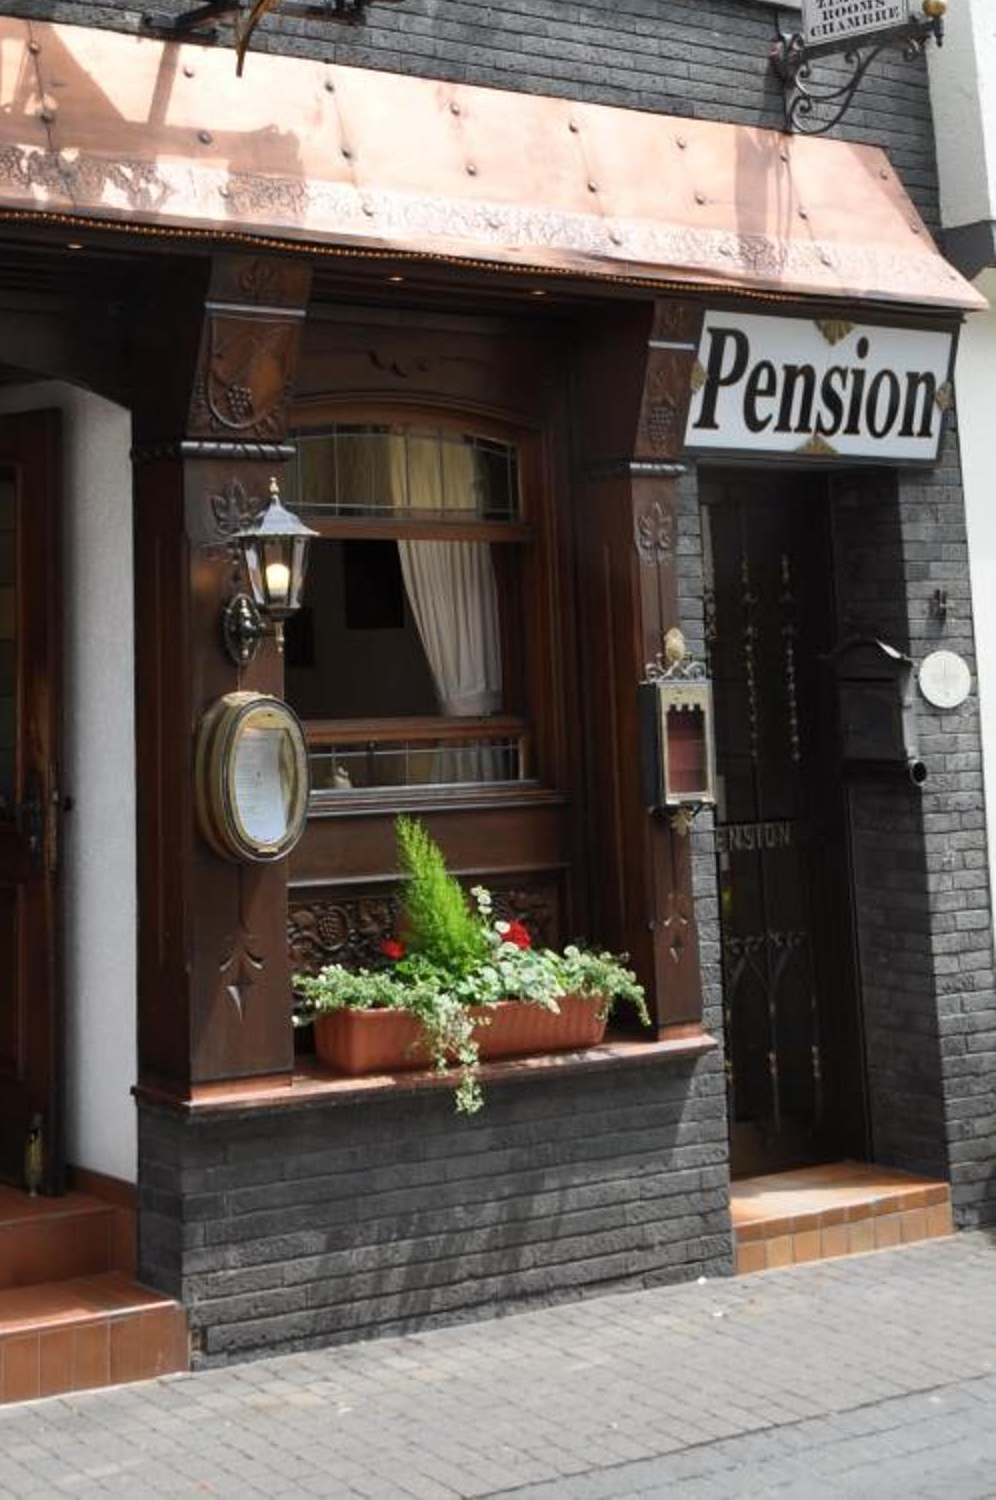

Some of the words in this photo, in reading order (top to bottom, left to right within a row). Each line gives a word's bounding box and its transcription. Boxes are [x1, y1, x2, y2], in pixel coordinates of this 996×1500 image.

[810, 5, 900, 37] CHAMBRE
[692, 326, 936, 439] Pension
[716, 820, 792, 851] ENSION
